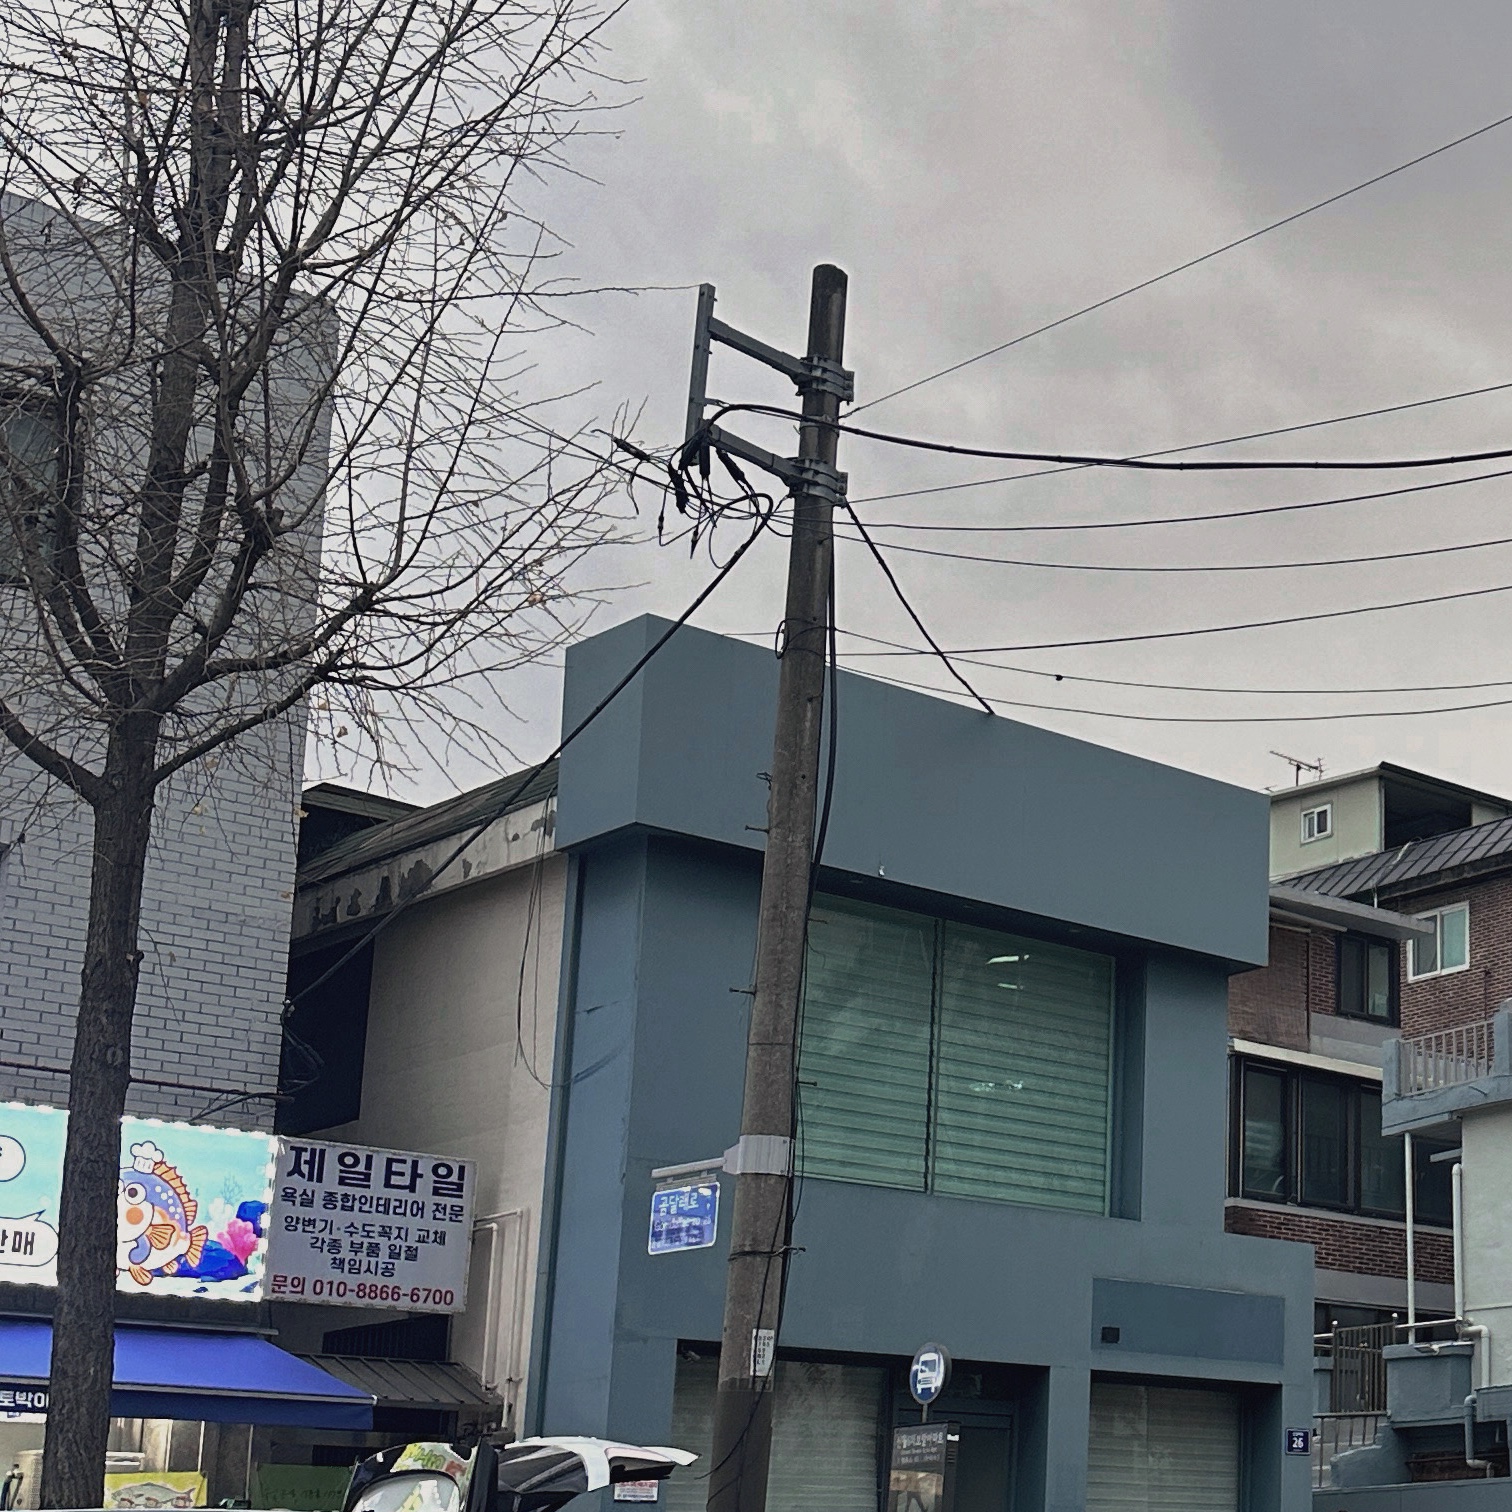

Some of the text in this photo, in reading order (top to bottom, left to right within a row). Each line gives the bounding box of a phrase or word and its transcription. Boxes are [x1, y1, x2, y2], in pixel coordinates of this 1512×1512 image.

[286, 1145, 466, 1200] 제일타일
[280, 1186, 465, 1224] 욕실 종합인테리어 전문
[309, 1236, 343, 1255] 각종
[349, 1239, 381, 1258] 부품
[414, 1227, 447, 1246] 교체
[329, 1256, 396, 1278] 책임시공
[271, 1274, 455, 1306] 문의 010-8866-6700
[1292, 1437, 1304, 1448] 26
